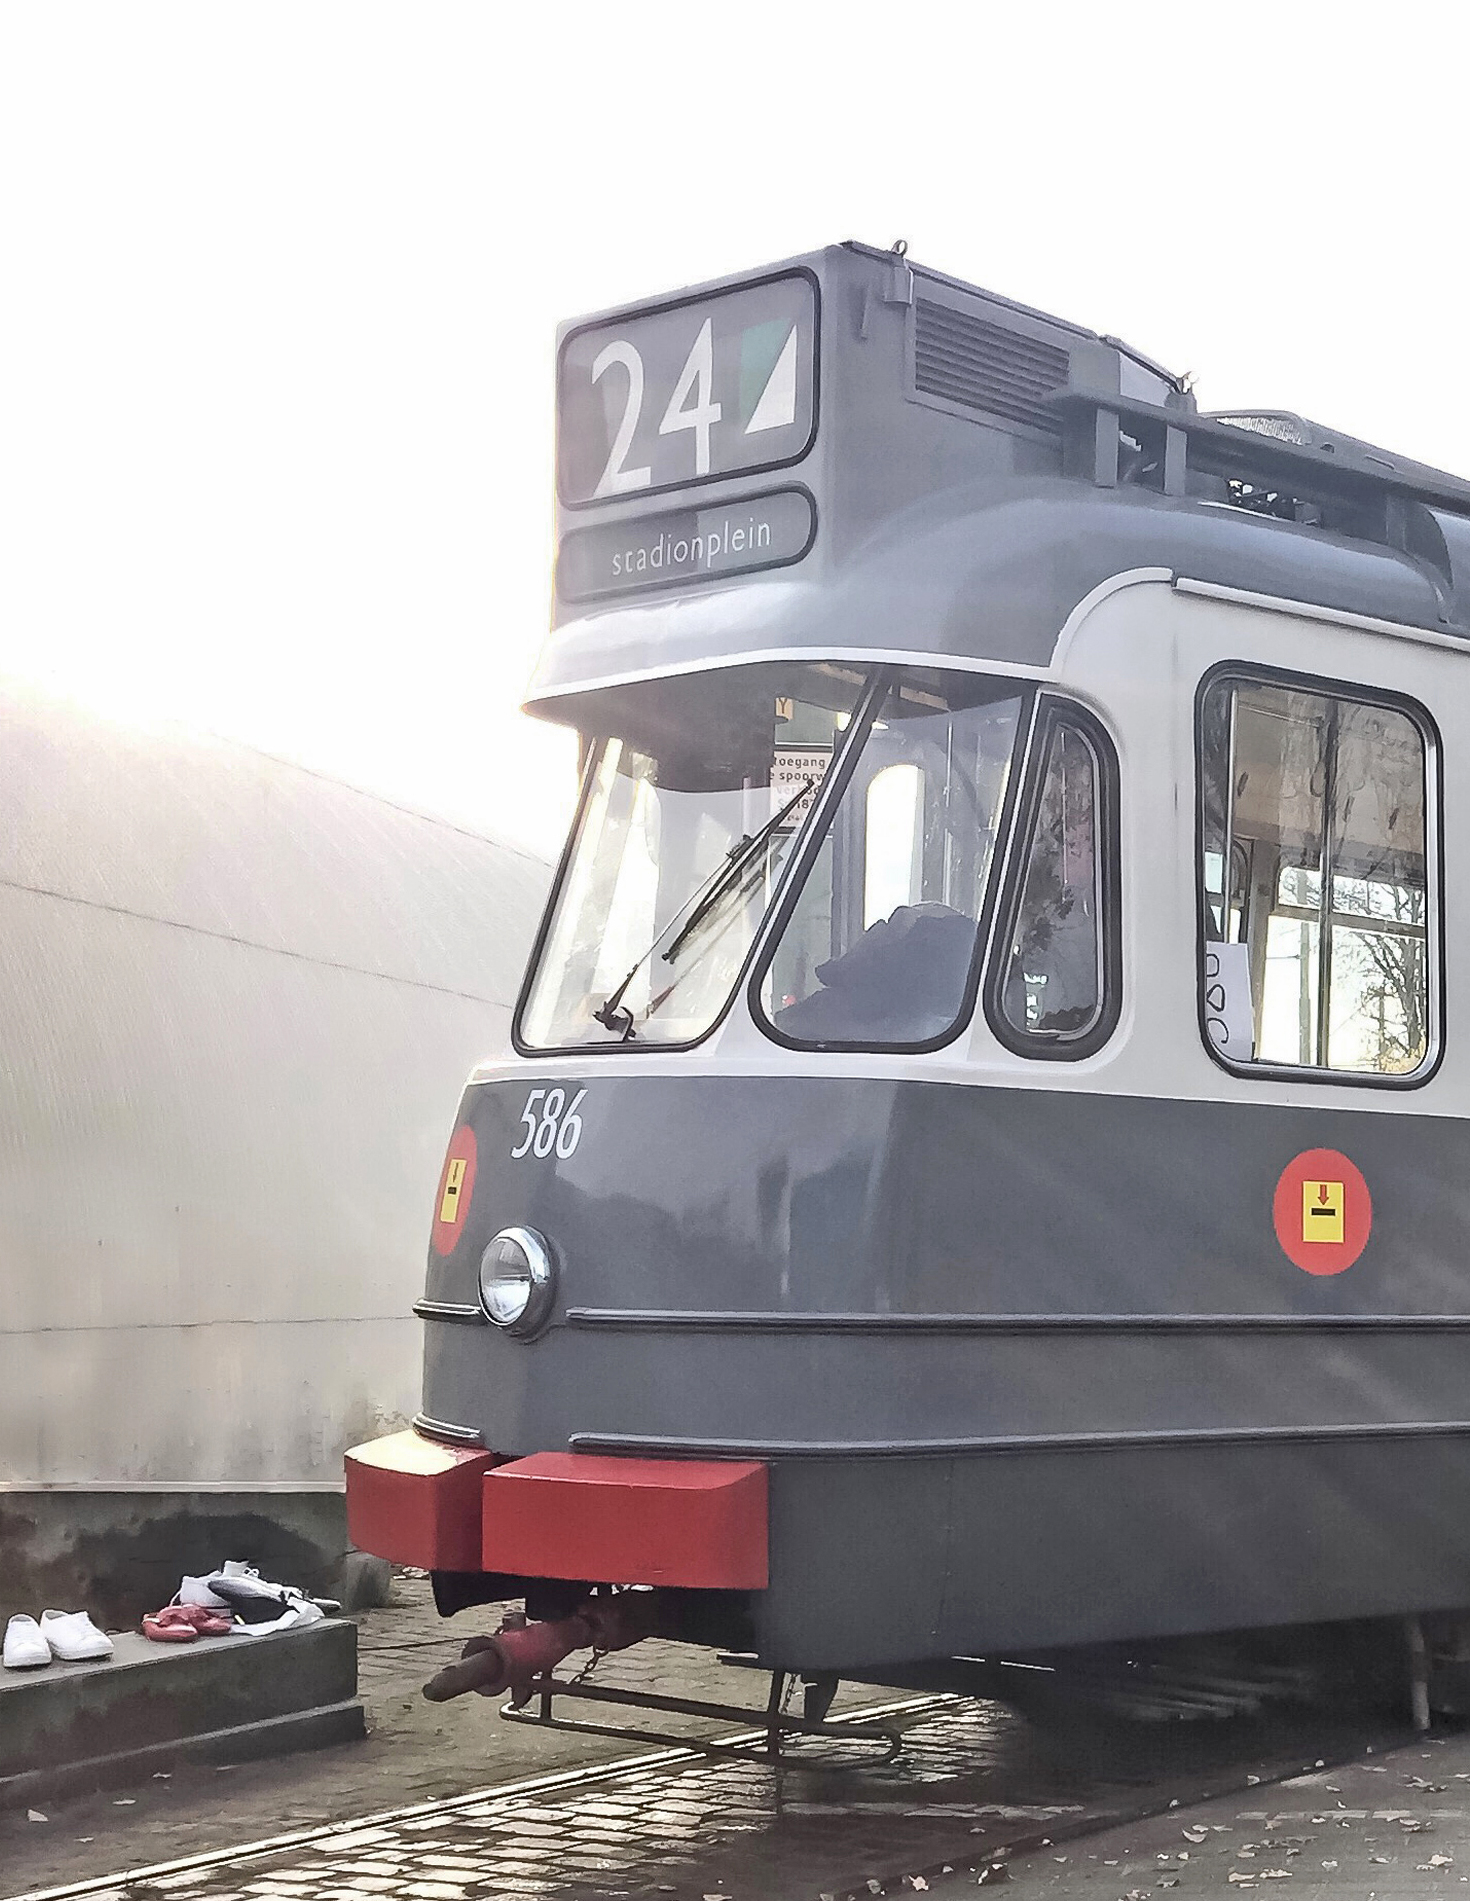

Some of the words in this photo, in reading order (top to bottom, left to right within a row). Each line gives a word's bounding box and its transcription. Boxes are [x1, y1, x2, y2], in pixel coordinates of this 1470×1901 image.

[591, 317, 722, 497] 24
[611, 517, 771, 576] stadionplein
[511, 1088, 588, 1159] 586
